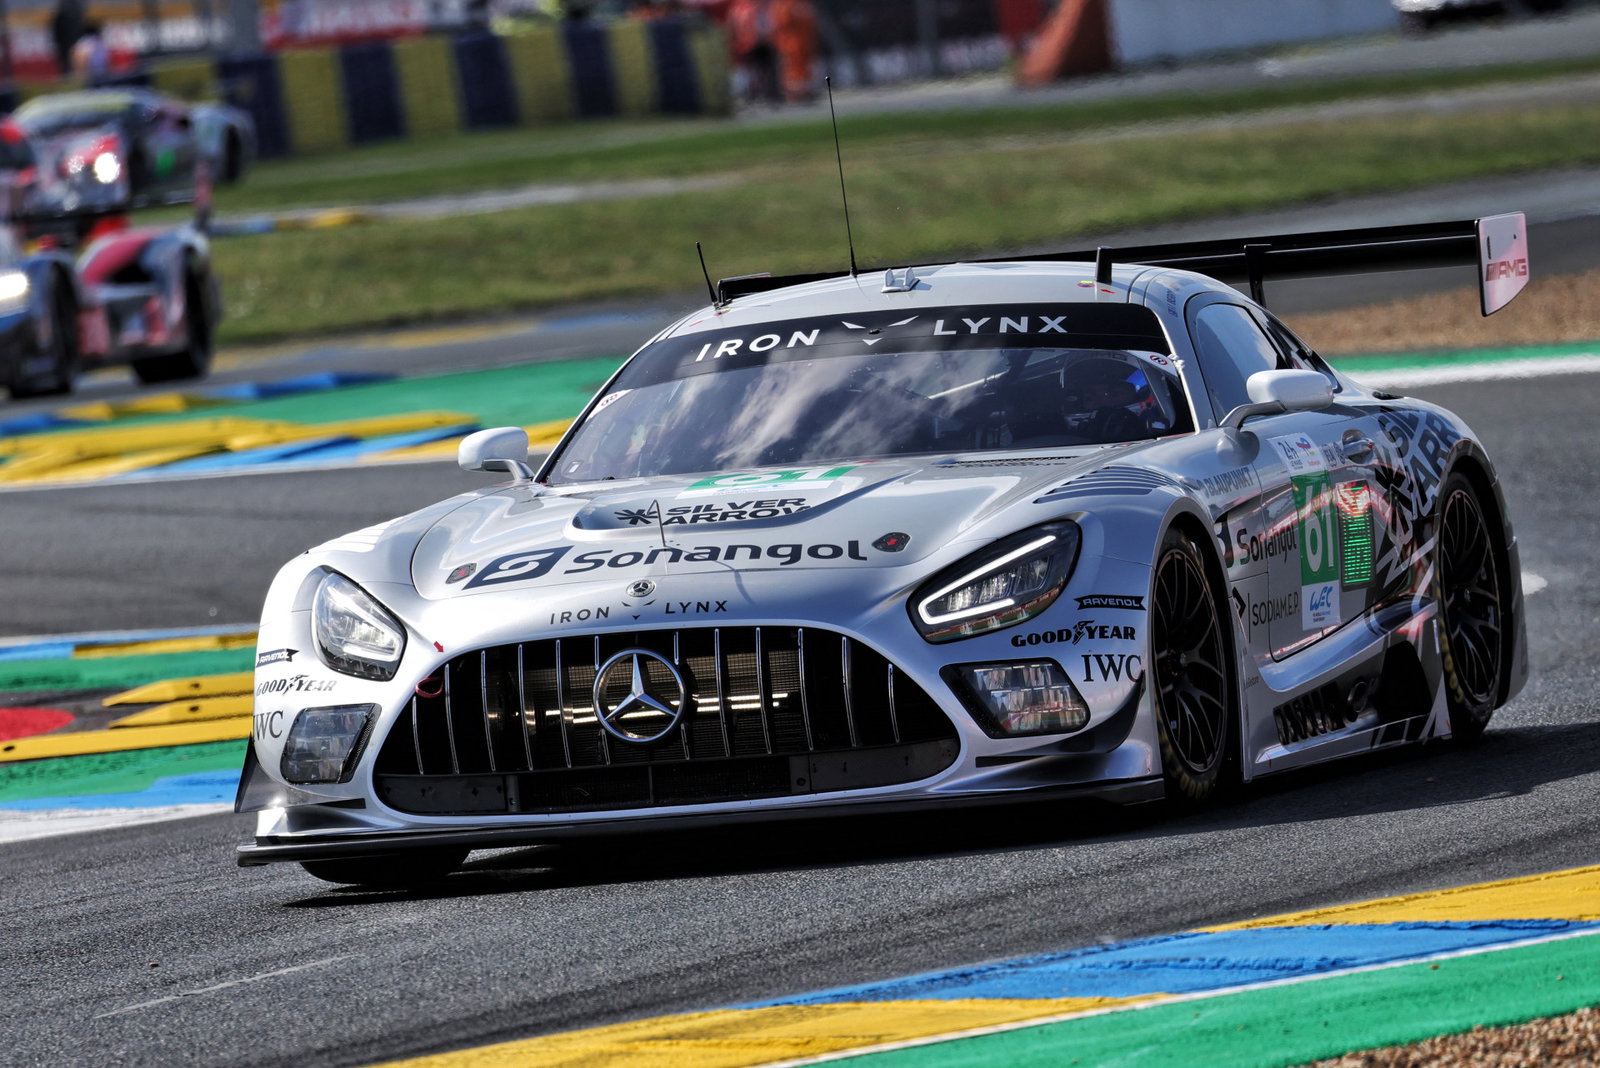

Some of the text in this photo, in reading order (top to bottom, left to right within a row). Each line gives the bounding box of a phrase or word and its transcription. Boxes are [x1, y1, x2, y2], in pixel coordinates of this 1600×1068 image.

[1499, 258, 1528, 279] AMG
[696, 315, 1068, 362] IRON LYNX
[662, 506, 811, 526] ARROW
[666, 498, 806, 515] SILVER
[1305, 483, 1334, 573] 61
[564, 541, 867, 575] Sonangol
[1236, 527, 1297, 566] Sonangol
[550, 600, 728, 624] IRON LYNX
[1083, 597, 1140, 608] RAVENOL
[1310, 586, 1333, 611] WEC
[1081, 654, 1142, 683] IWC
[253, 710, 284, 740] WC
